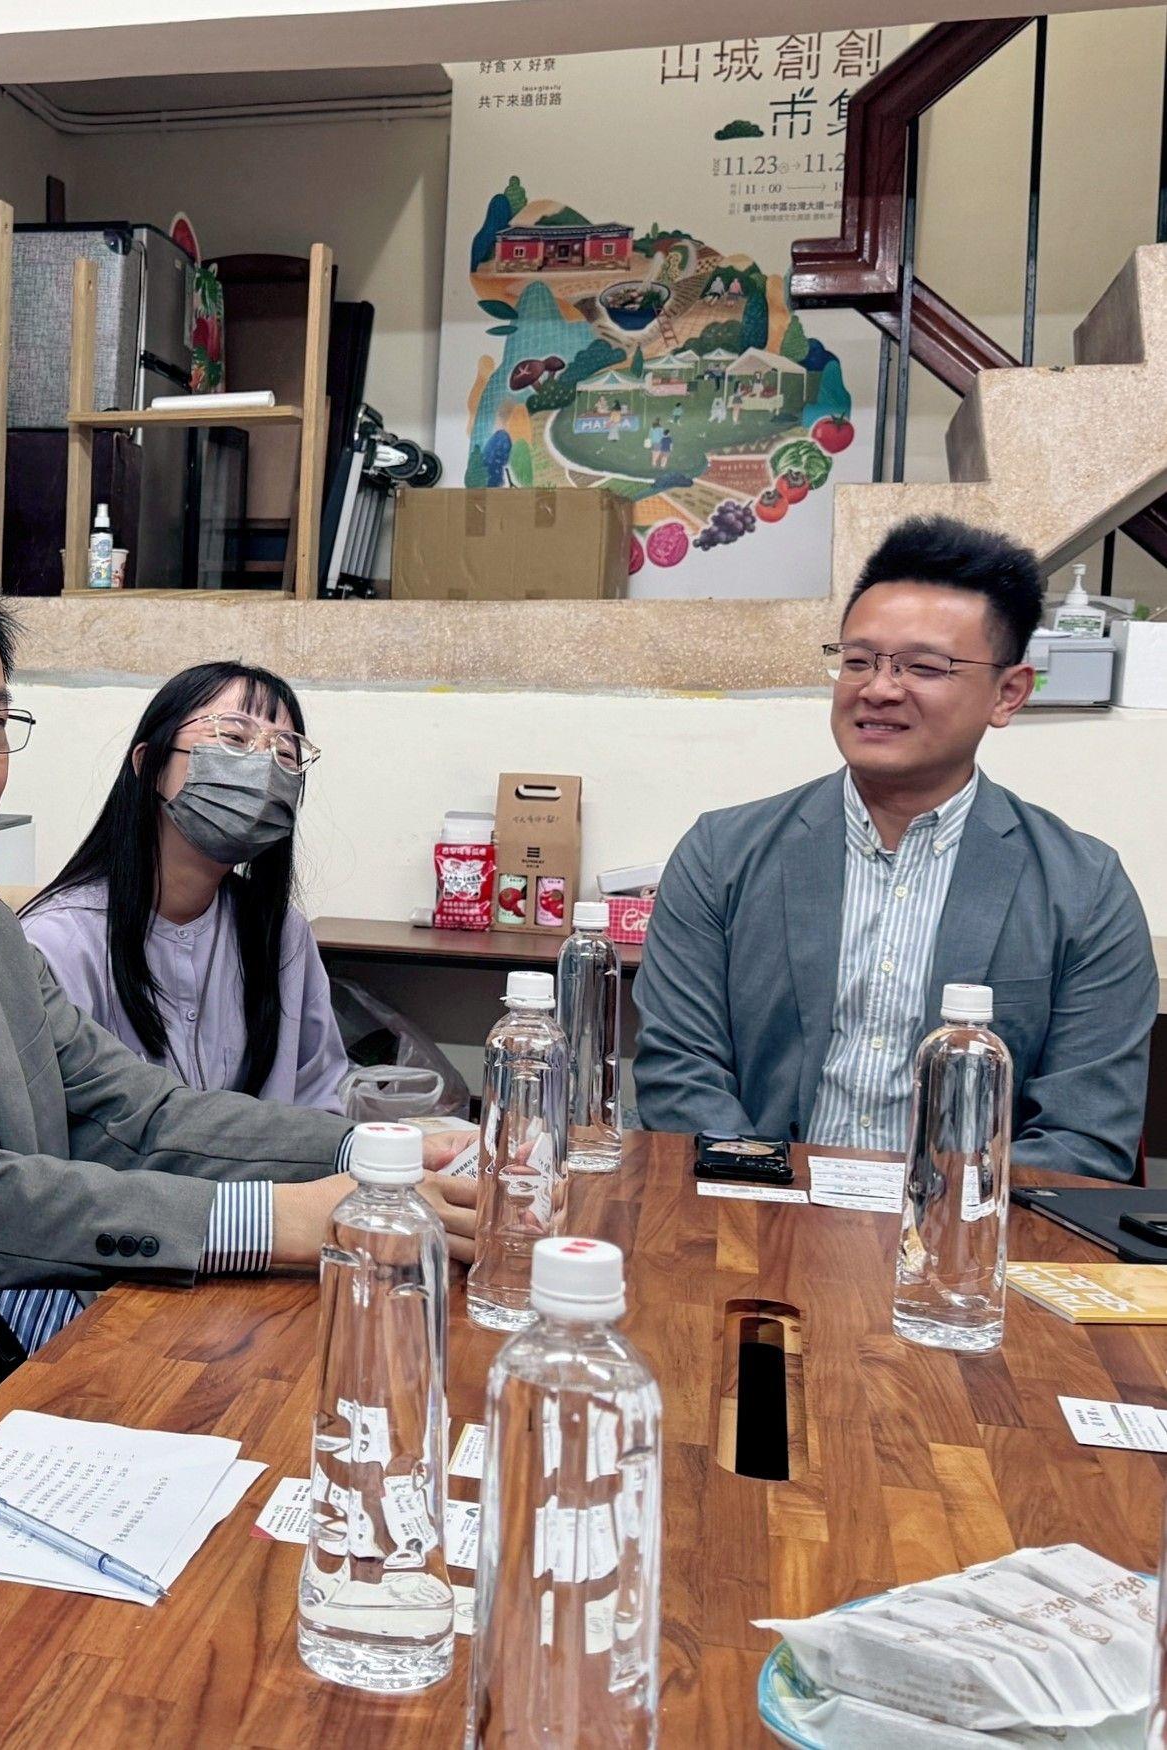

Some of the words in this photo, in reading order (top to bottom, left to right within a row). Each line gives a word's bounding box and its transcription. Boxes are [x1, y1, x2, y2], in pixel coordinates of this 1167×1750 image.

[661, 29, 882, 85] 山城創創
[724, 155, 778, 176] 11.23
[804, 152, 846, 173] 11.2
